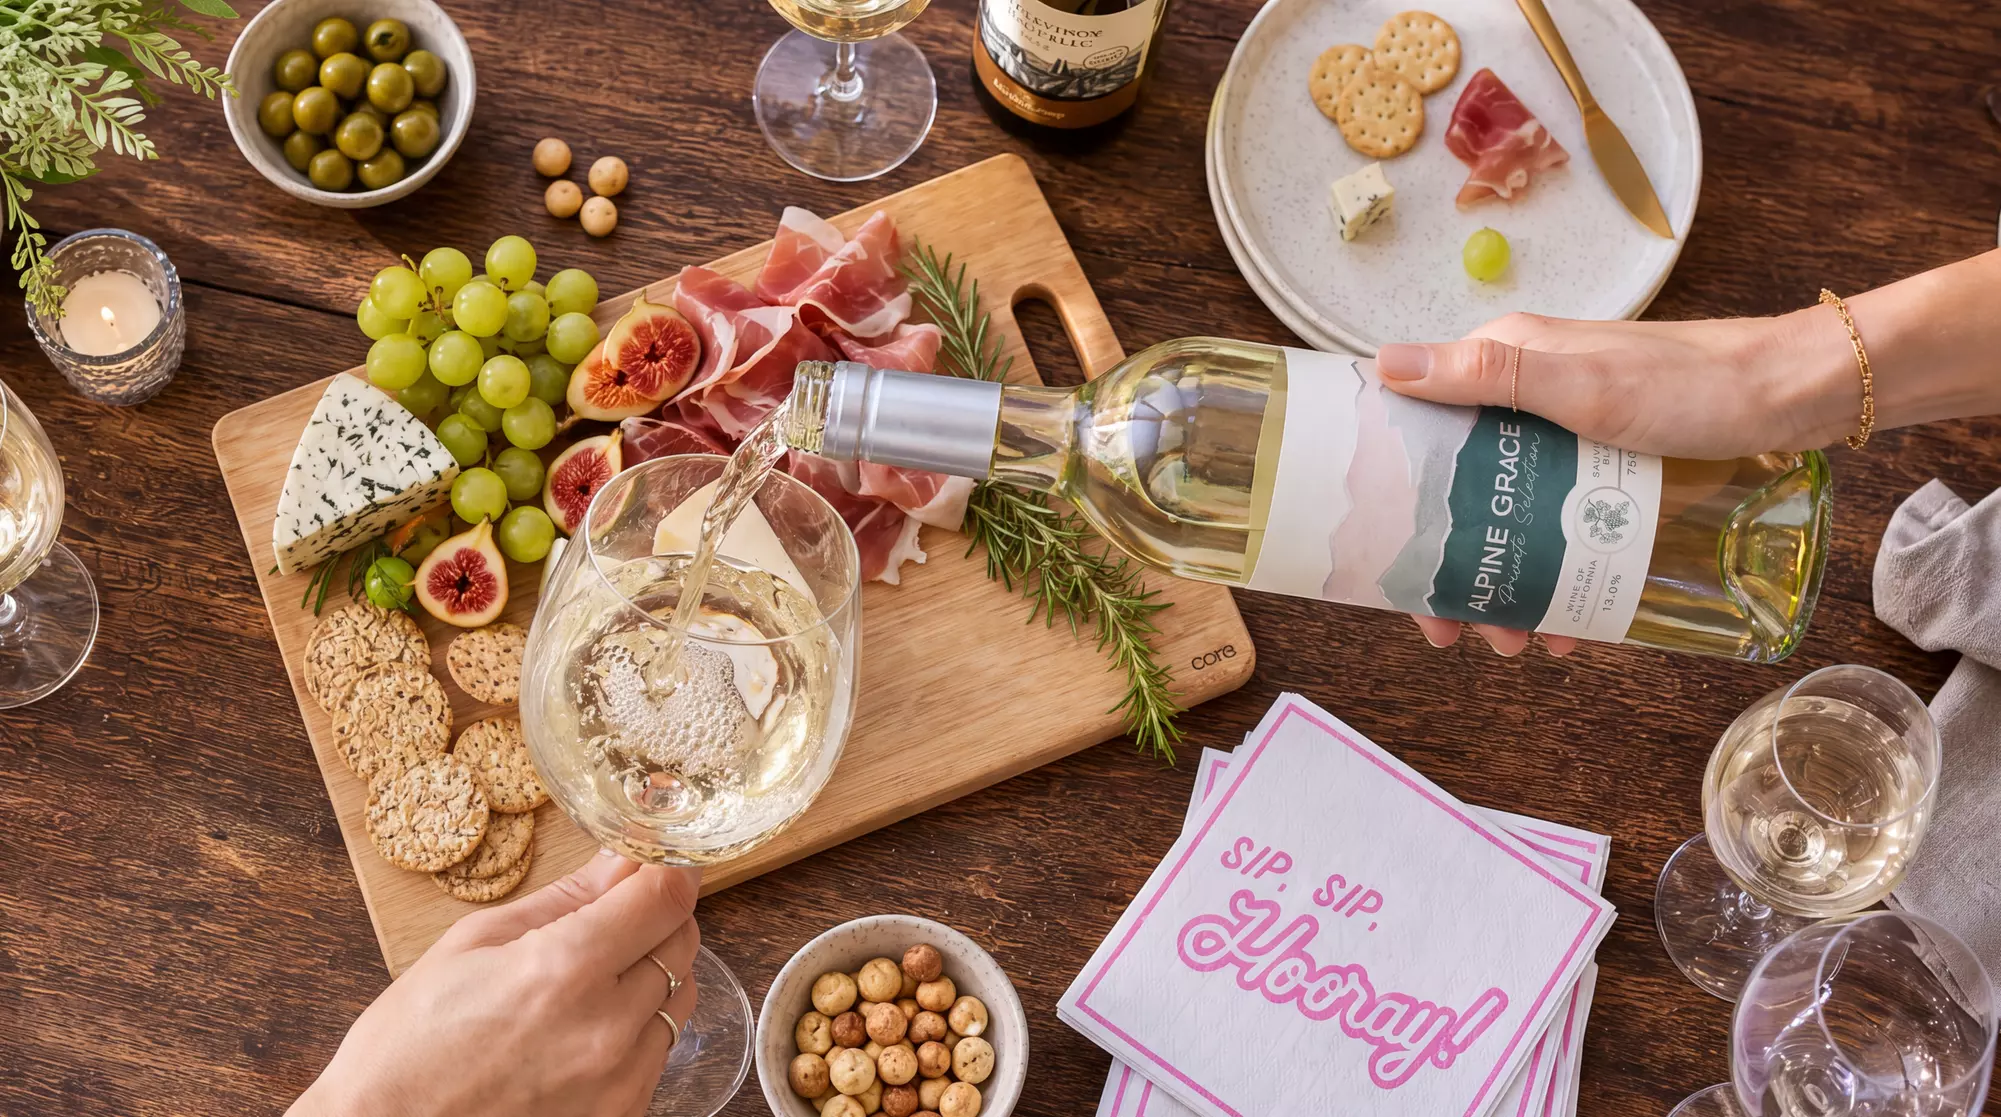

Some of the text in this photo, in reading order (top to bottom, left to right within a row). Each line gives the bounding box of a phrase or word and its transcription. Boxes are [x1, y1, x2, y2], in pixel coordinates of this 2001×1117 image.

[1467, 422, 1521, 612] ALPINE GRACE
[1498, 432, 1541, 605] Private Selection
[1566, 567, 1586, 612] WINE OF
[1572, 559, 1598, 622] CALIFORNIA
[1602, 574, 1622, 612] 13.0%
[1191, 644, 1237, 670] core
[1220, 836, 1384, 931] SIP, SIP,
[1177, 889, 1509, 1089] Hooray!
